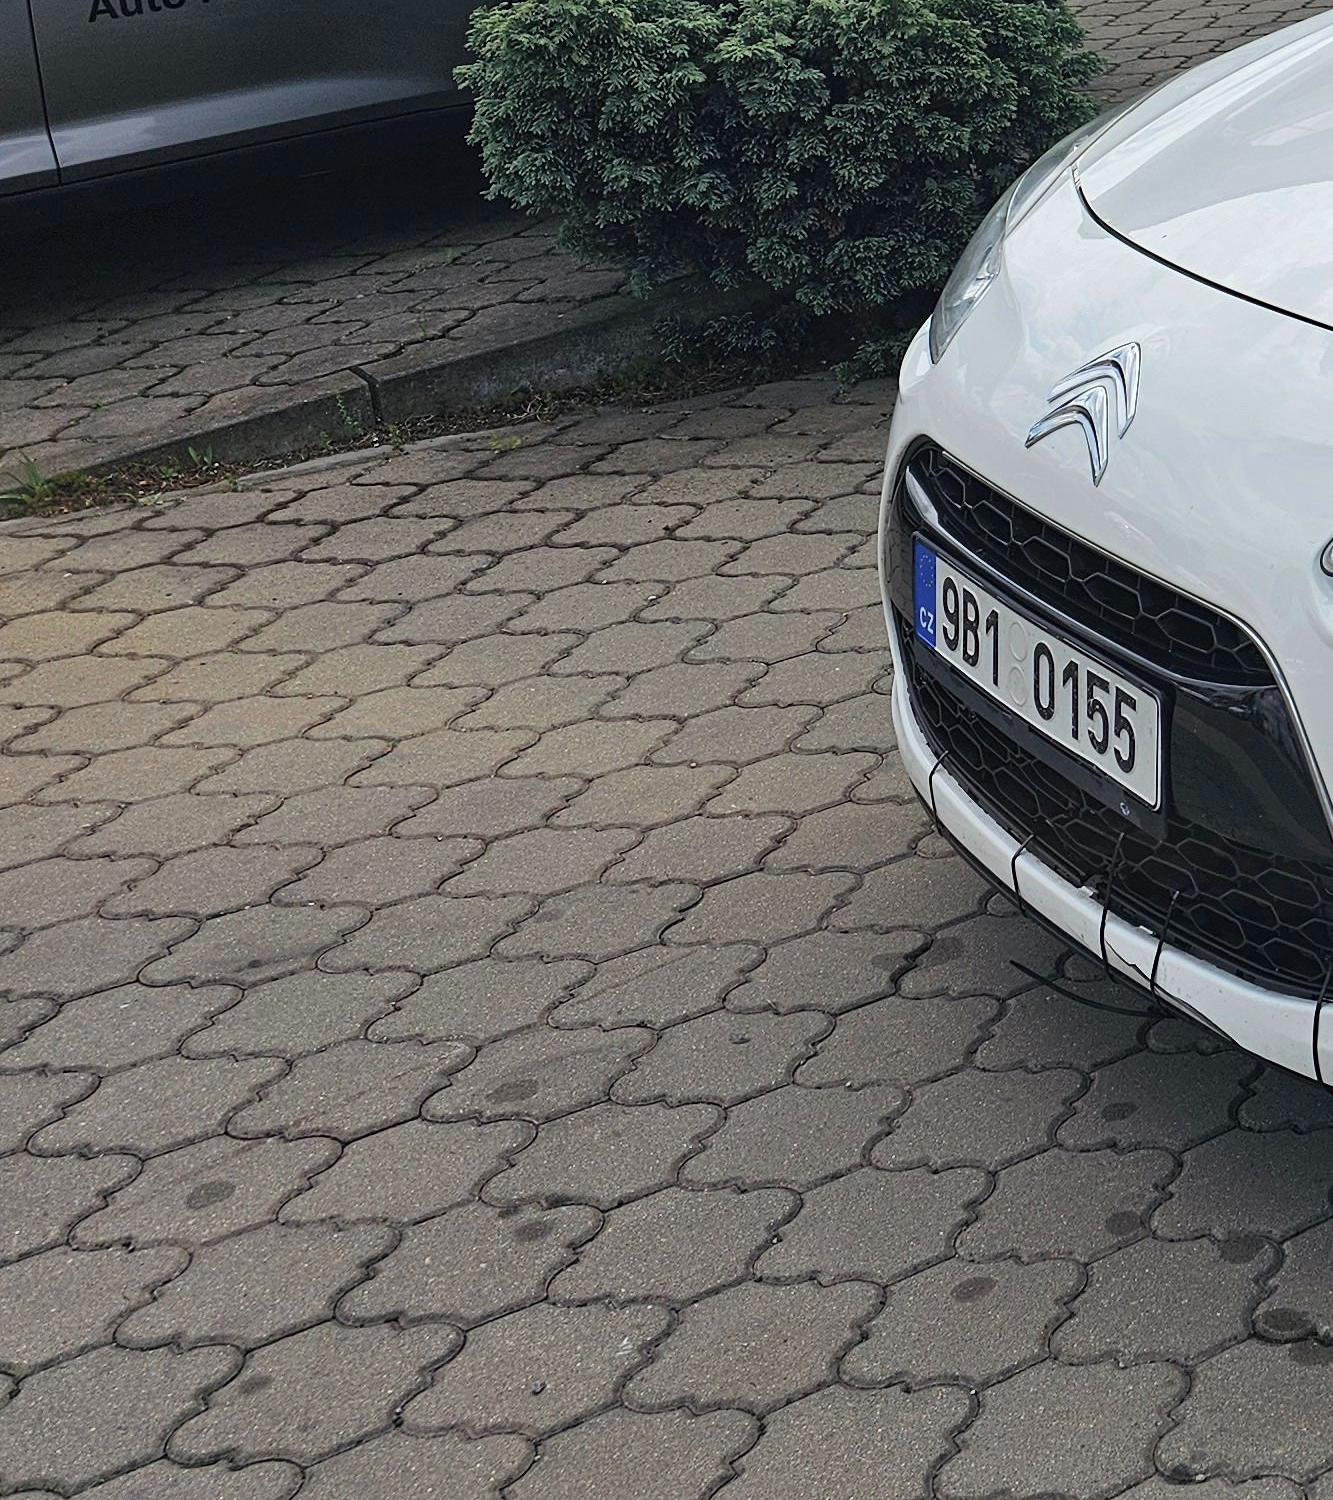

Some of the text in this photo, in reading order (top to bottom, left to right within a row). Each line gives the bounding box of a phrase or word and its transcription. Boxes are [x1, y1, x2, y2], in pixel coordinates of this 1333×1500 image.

[919, 606, 934, 635] CZ
[941, 576, 1137, 774] 9B1 0155
